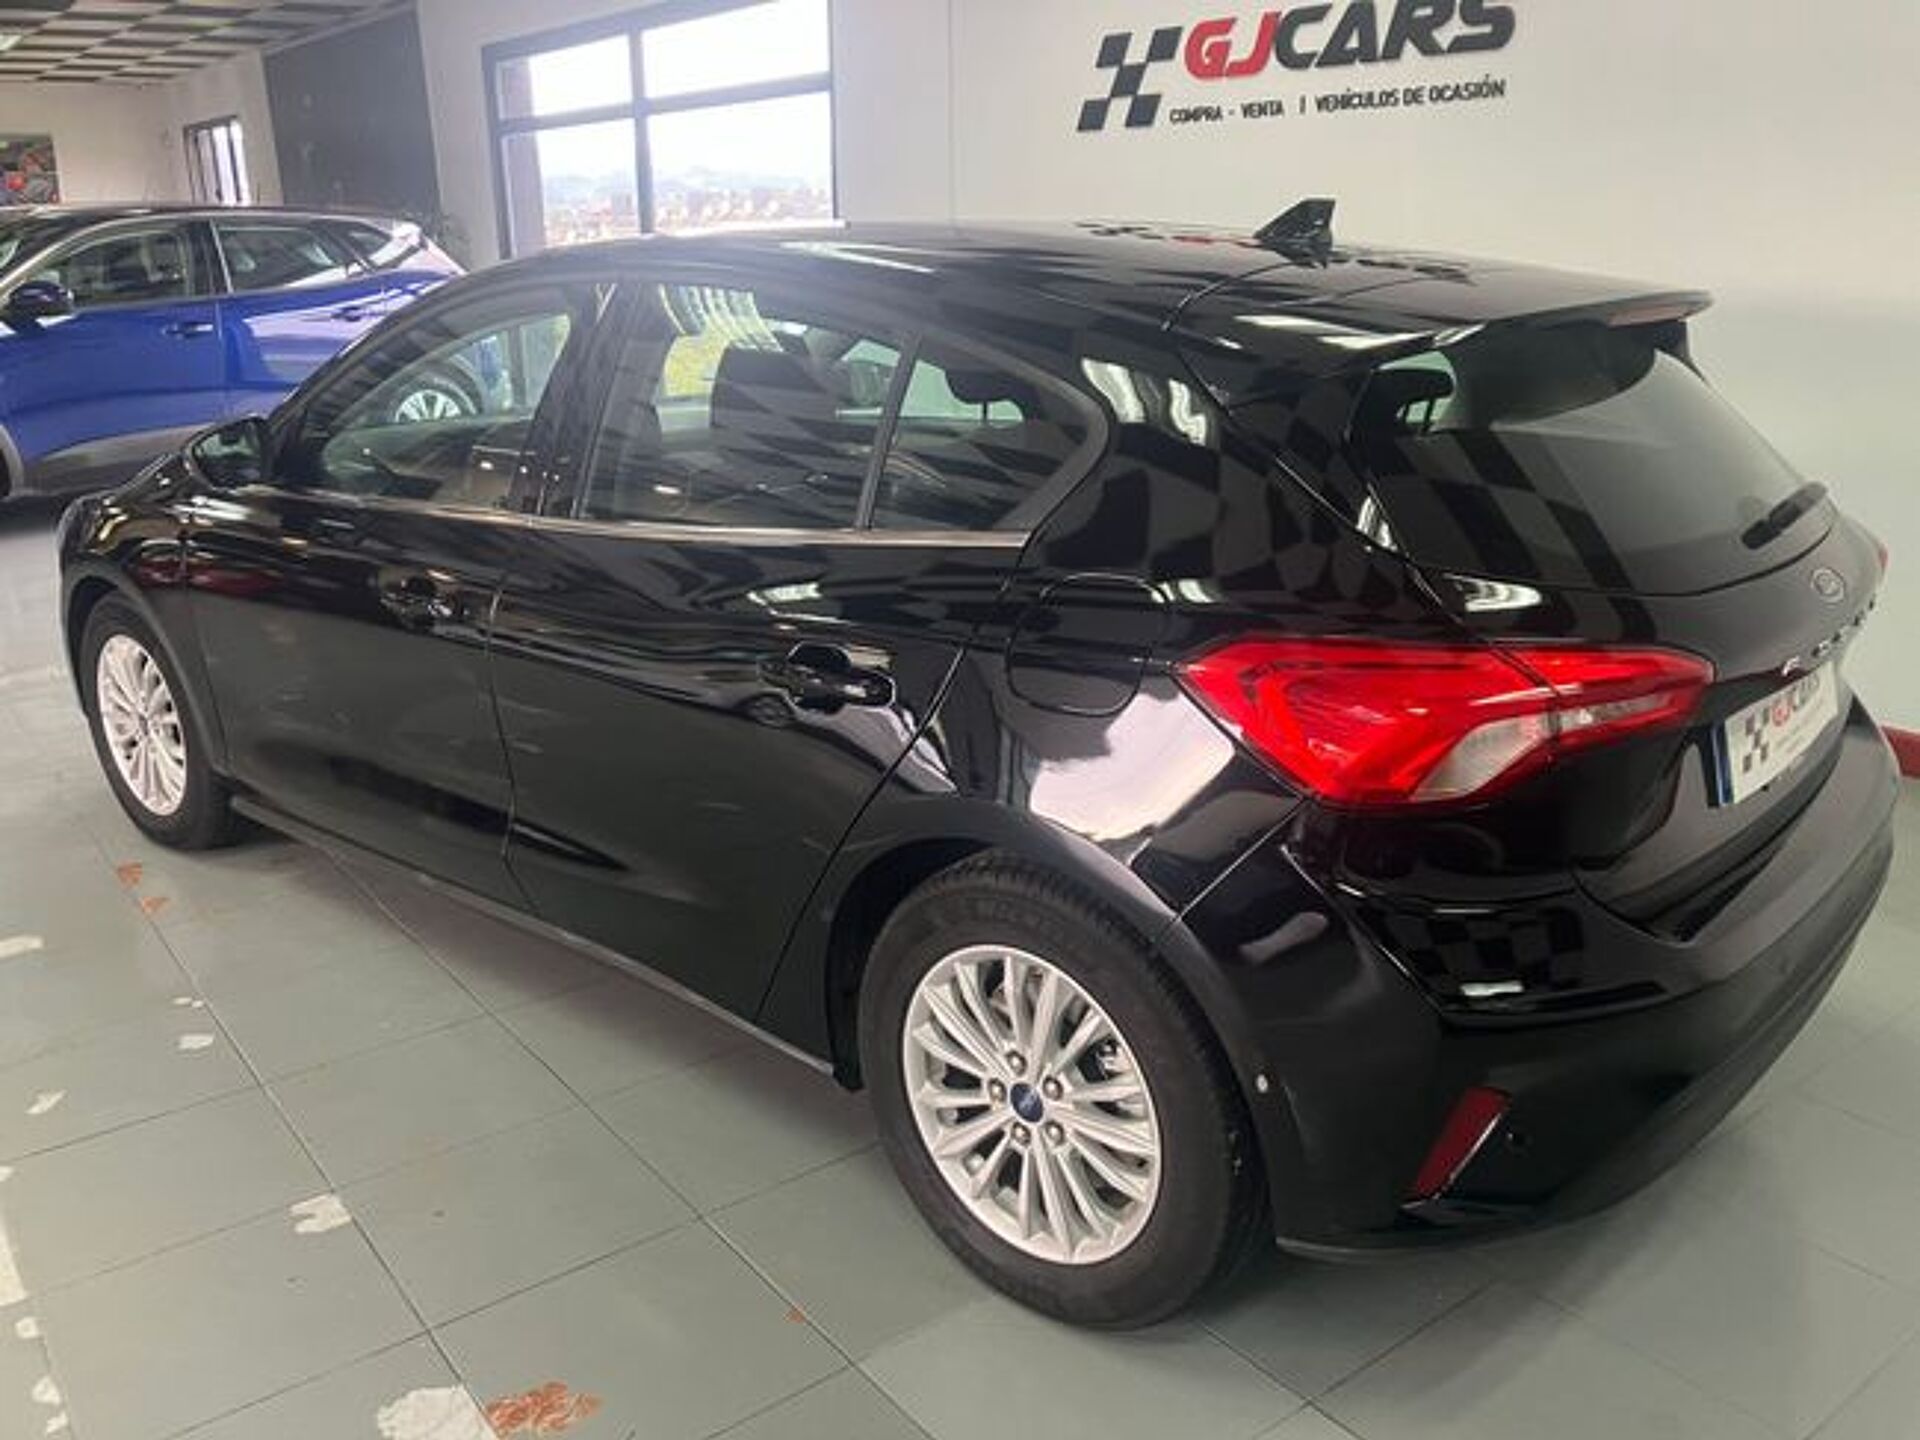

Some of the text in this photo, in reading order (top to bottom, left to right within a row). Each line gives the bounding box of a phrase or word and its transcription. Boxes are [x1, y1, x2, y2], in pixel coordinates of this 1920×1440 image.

[1184, 0, 1516, 79] GJCARS
[1169, 106, 1223, 124] COMPRA
[1241, 100, 1284, 118] VENTA
[1315, 88, 1400, 112] VEHÍCULOS
[1403, 87, 1426, 106] DE
[1429, 74, 1506, 102] OCASIÓN
